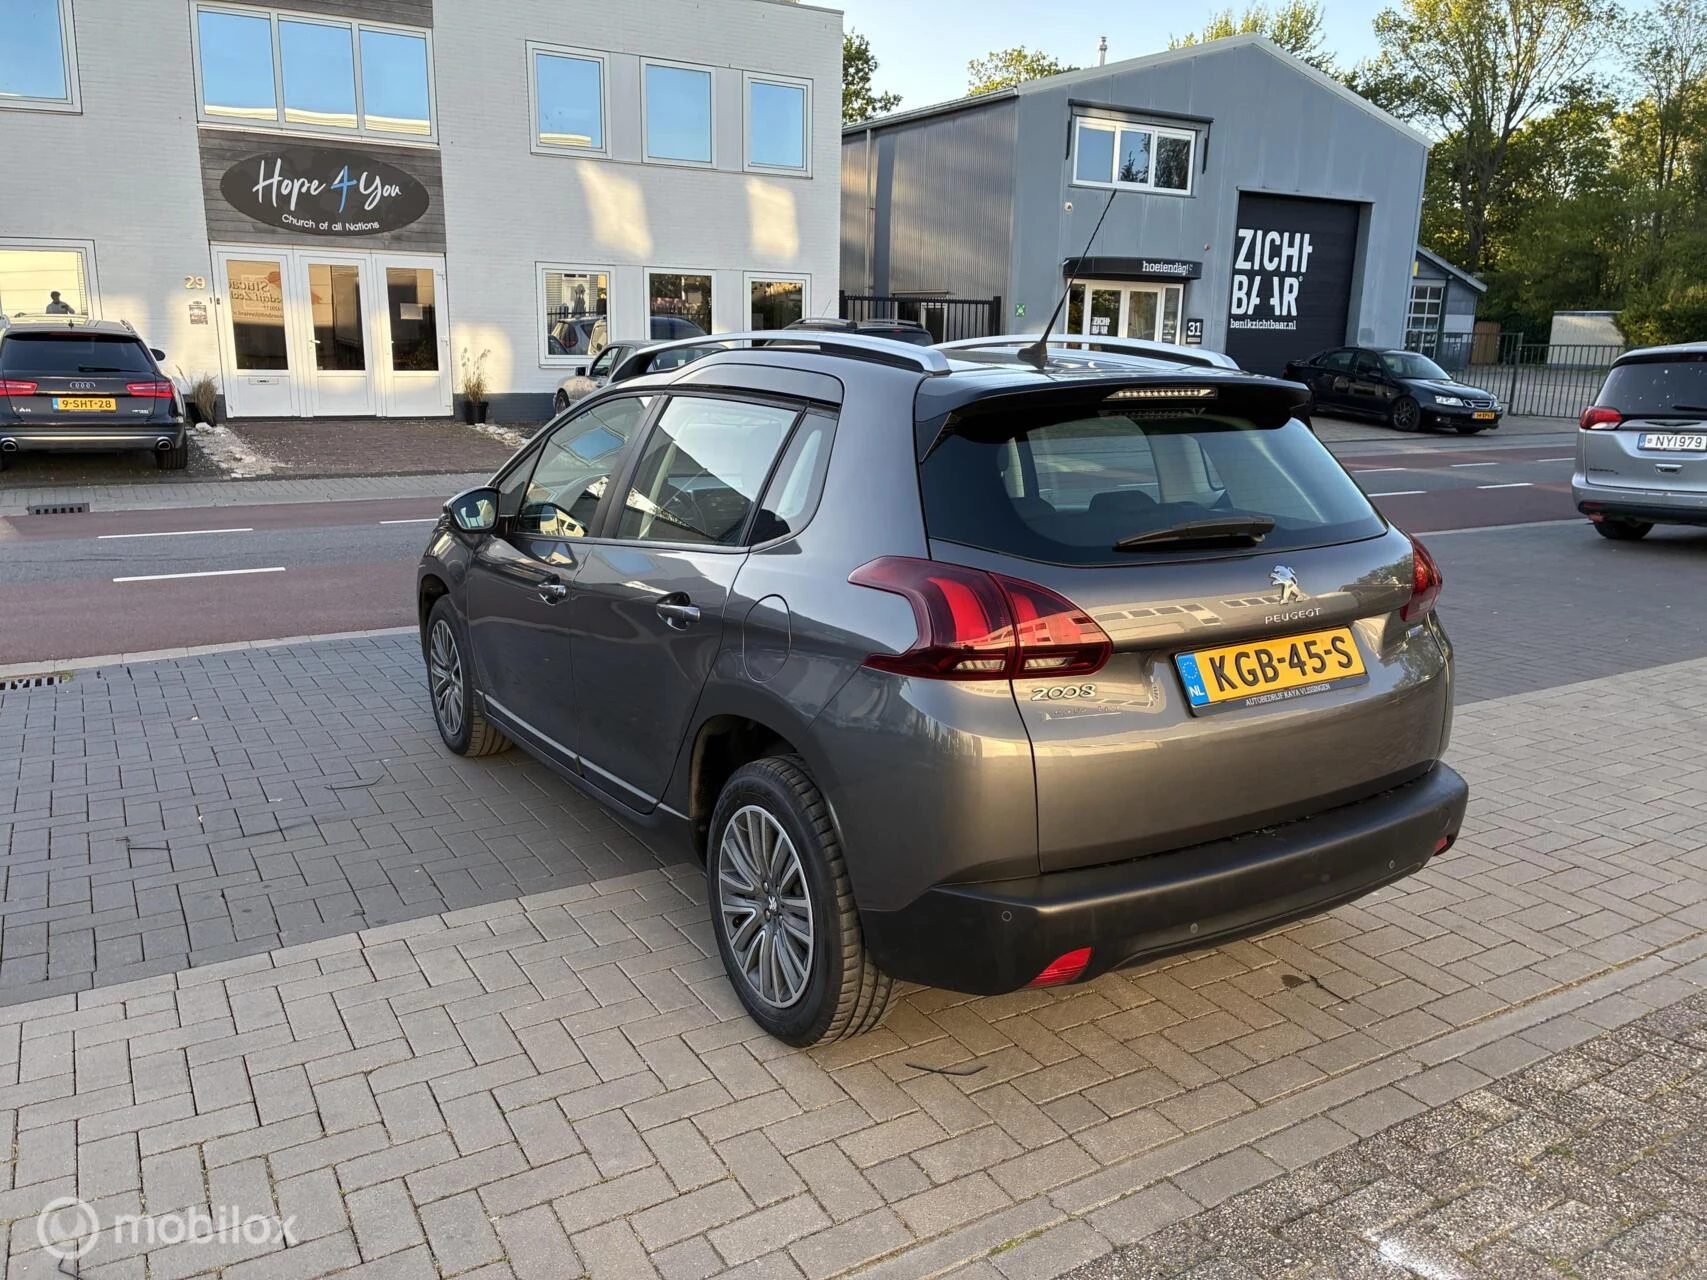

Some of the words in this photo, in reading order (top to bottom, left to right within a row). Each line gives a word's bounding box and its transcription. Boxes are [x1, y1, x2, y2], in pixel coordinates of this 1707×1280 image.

[252, 158, 326, 211] Hope
[331, 165, 357, 213] 4
[359, 171, 401, 210] You
[282, 213, 315, 228] Church
[319, 221, 328, 230] of
[332, 222, 342, 231] all
[346, 221, 379, 231] Nations
[185, 276, 206, 289] 29
[1187, 321, 1201, 335] 31
[1230, 318, 1297, 330] benikzichtbaar.nl
[62, 399, 112, 408] 9-SHT-28
[1265, 608, 1321, 624] PEUGEOT
[1188, 685, 1205, 697] NL
[1209, 636, 1353, 692] KGB-45-S
[1031, 684, 1096, 701] 2008
[1246, 691, 1284, 706] AUTOBEDRIJF
[1284, 688, 1301, 699] KAYA
[1300, 682, 1331, 695] VLISSINGEN
